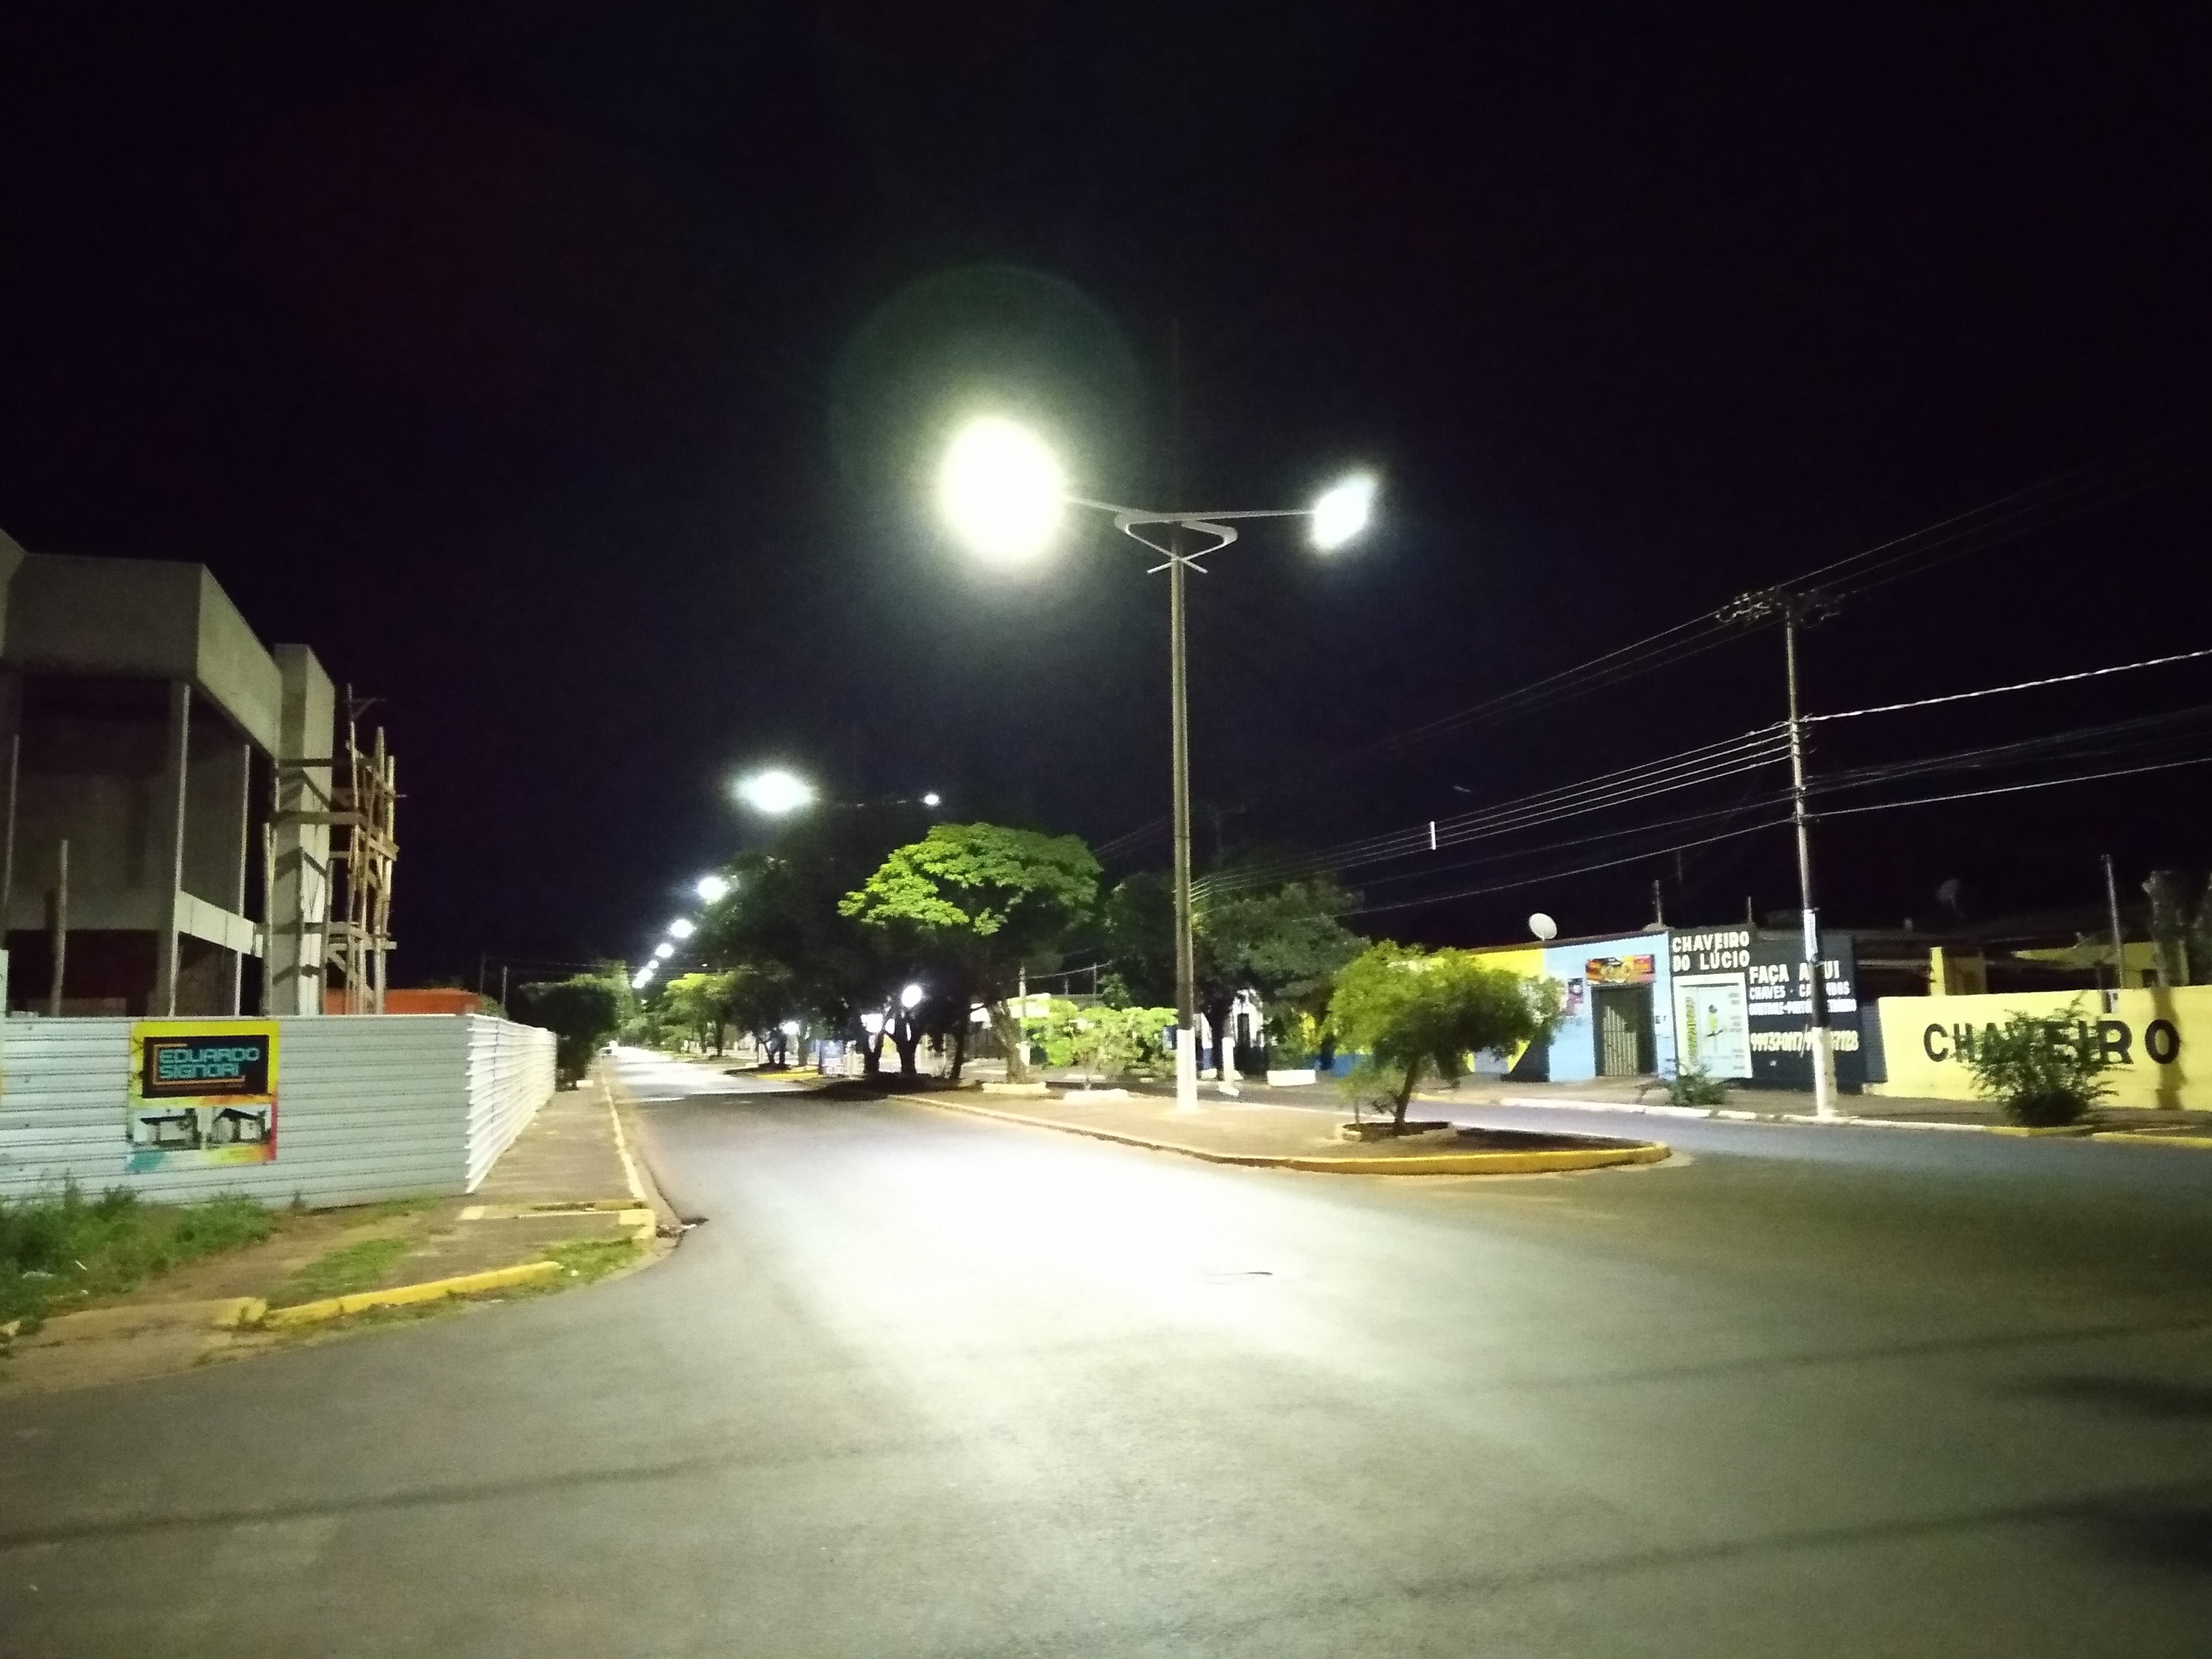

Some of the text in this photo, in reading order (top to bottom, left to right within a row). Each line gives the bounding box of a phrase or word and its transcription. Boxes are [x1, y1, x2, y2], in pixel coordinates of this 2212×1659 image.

[1672, 931, 1750, 952] CHAVEIRO
[1673, 954, 1691, 972] DO
[1749, 960, 1840, 985] FAÇA AUI
[1749, 985, 1786, 1000] CHAVES
[1923, 1019, 2181, 1065] CHAEIRO
[159, 1047, 260, 1063] EDUARDO
[159, 1063, 239, 1079] SIGNORI
